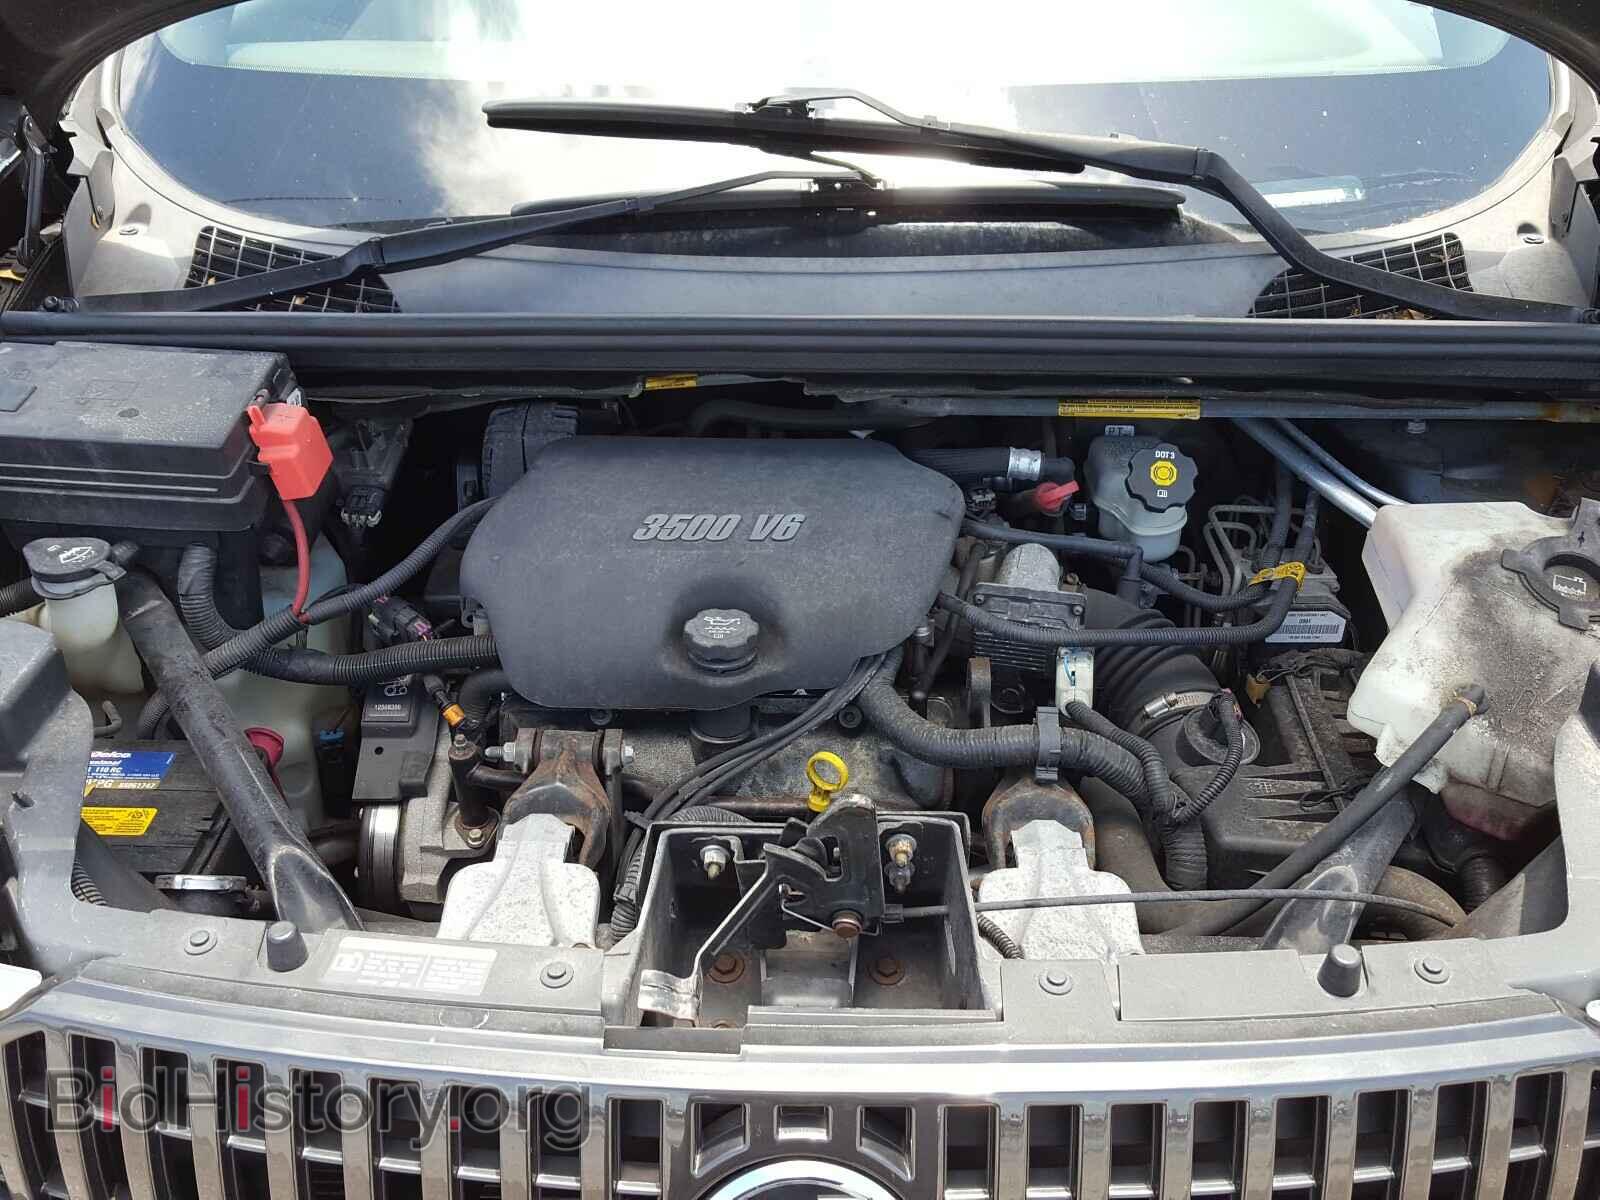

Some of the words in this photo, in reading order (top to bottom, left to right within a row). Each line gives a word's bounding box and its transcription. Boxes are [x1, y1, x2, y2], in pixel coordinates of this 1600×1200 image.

[1155, 450, 1169, 458] DOT
[633, 513, 742, 542] 3500
[747, 513, 807, 542] V6
